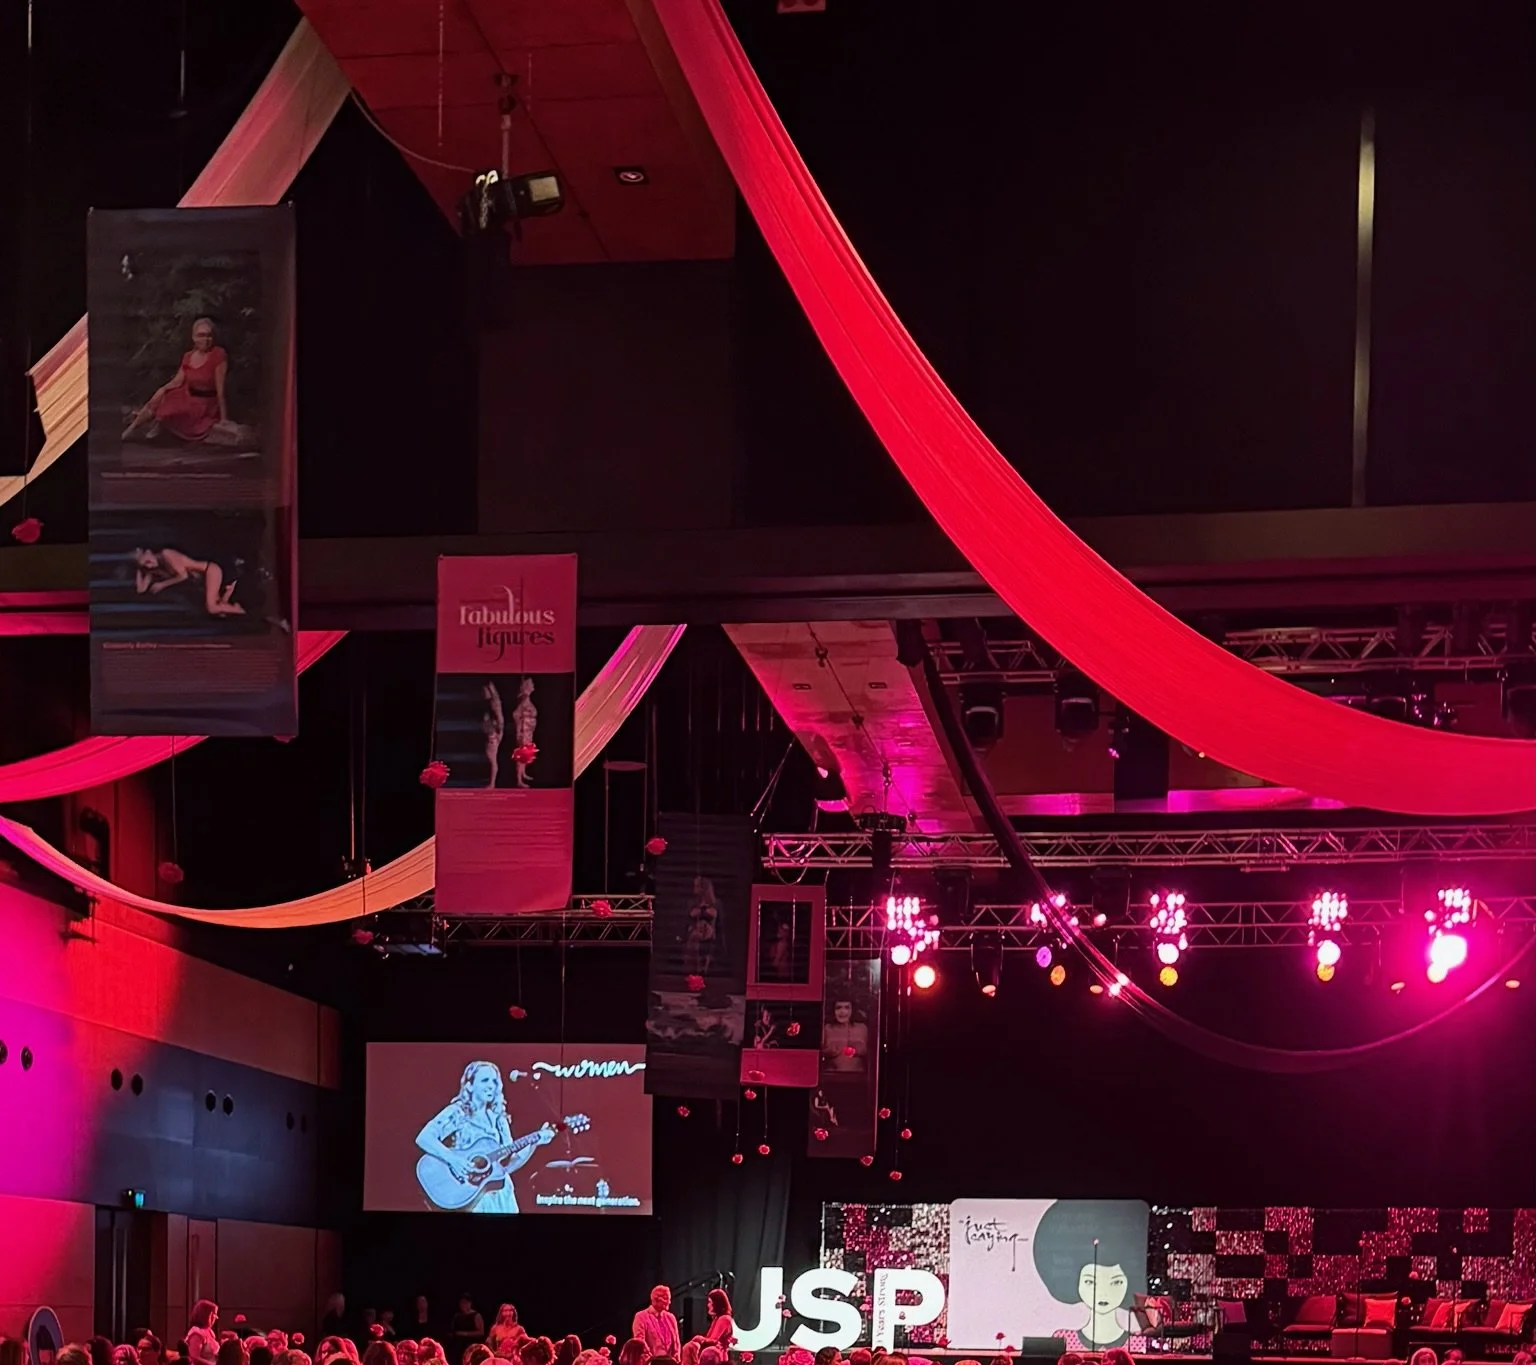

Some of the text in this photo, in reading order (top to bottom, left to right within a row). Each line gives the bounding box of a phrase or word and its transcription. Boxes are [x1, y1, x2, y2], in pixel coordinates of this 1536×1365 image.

[459, 585, 556, 625] fabulous
[476, 626, 556, 663] figures
[540, 1059, 646, 1078] women
